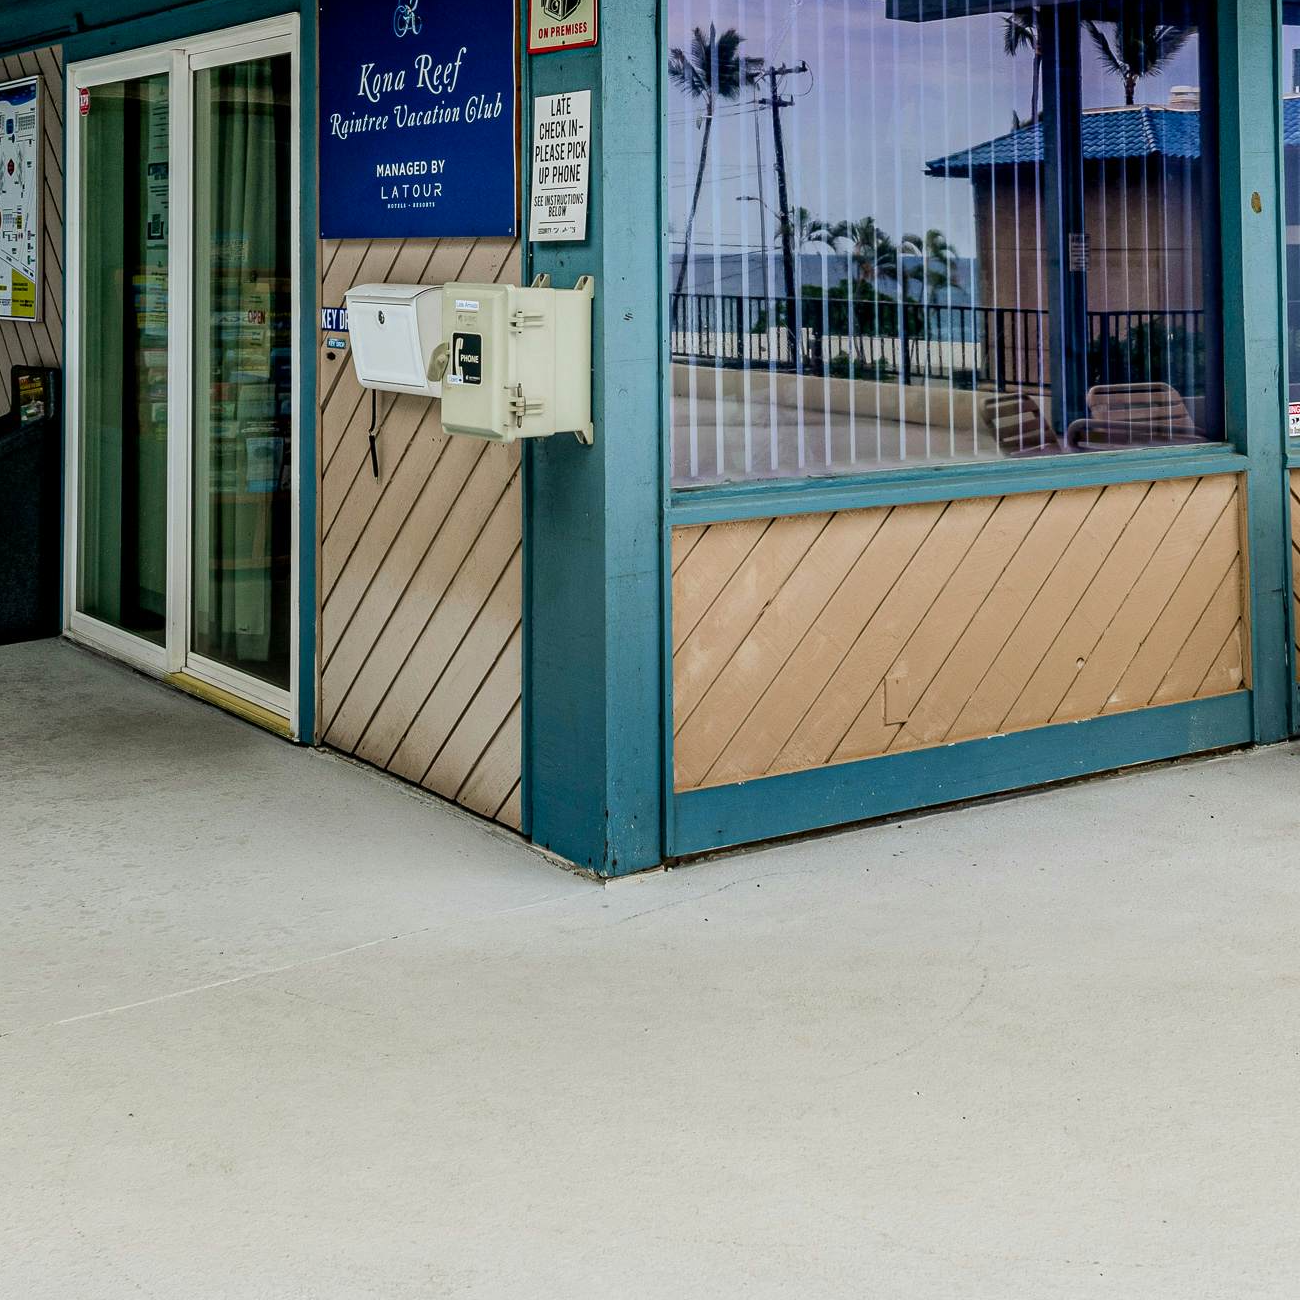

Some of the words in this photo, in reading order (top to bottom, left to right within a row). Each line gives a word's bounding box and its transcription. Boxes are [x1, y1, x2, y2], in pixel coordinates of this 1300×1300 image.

[538, 27, 549, 39] ON
[551, 22, 587, 37] PREMISES
[358, 63, 406, 103] Kona
[415, 47, 467, 95] Reef
[551, 97, 571, 116] LATE
[330, 111, 389, 140] Raintree
[393, 100, 460, 128] Vacation
[465, 92, 502, 123] Club
[539, 120, 566, 140] CHECK
[535, 143, 565, 163] PLEASE
[567, 140, 586, 159] PICK
[376, 161, 427, 177] MANAGED
[431, 159, 445, 174] BY
[539, 167, 549, 184] UP
[552, 164, 581, 183] PHONE
[381, 183, 442, 199] LATOUR
[534, 196, 543, 207] SEE
[545, 193, 584, 206] INSTRUCTIONS
[548, 205, 567, 217] BELOW
[248, 309, 265, 325] OPEN
[321, 309, 337, 329] KEY
[460, 354, 479, 364] PHONE
